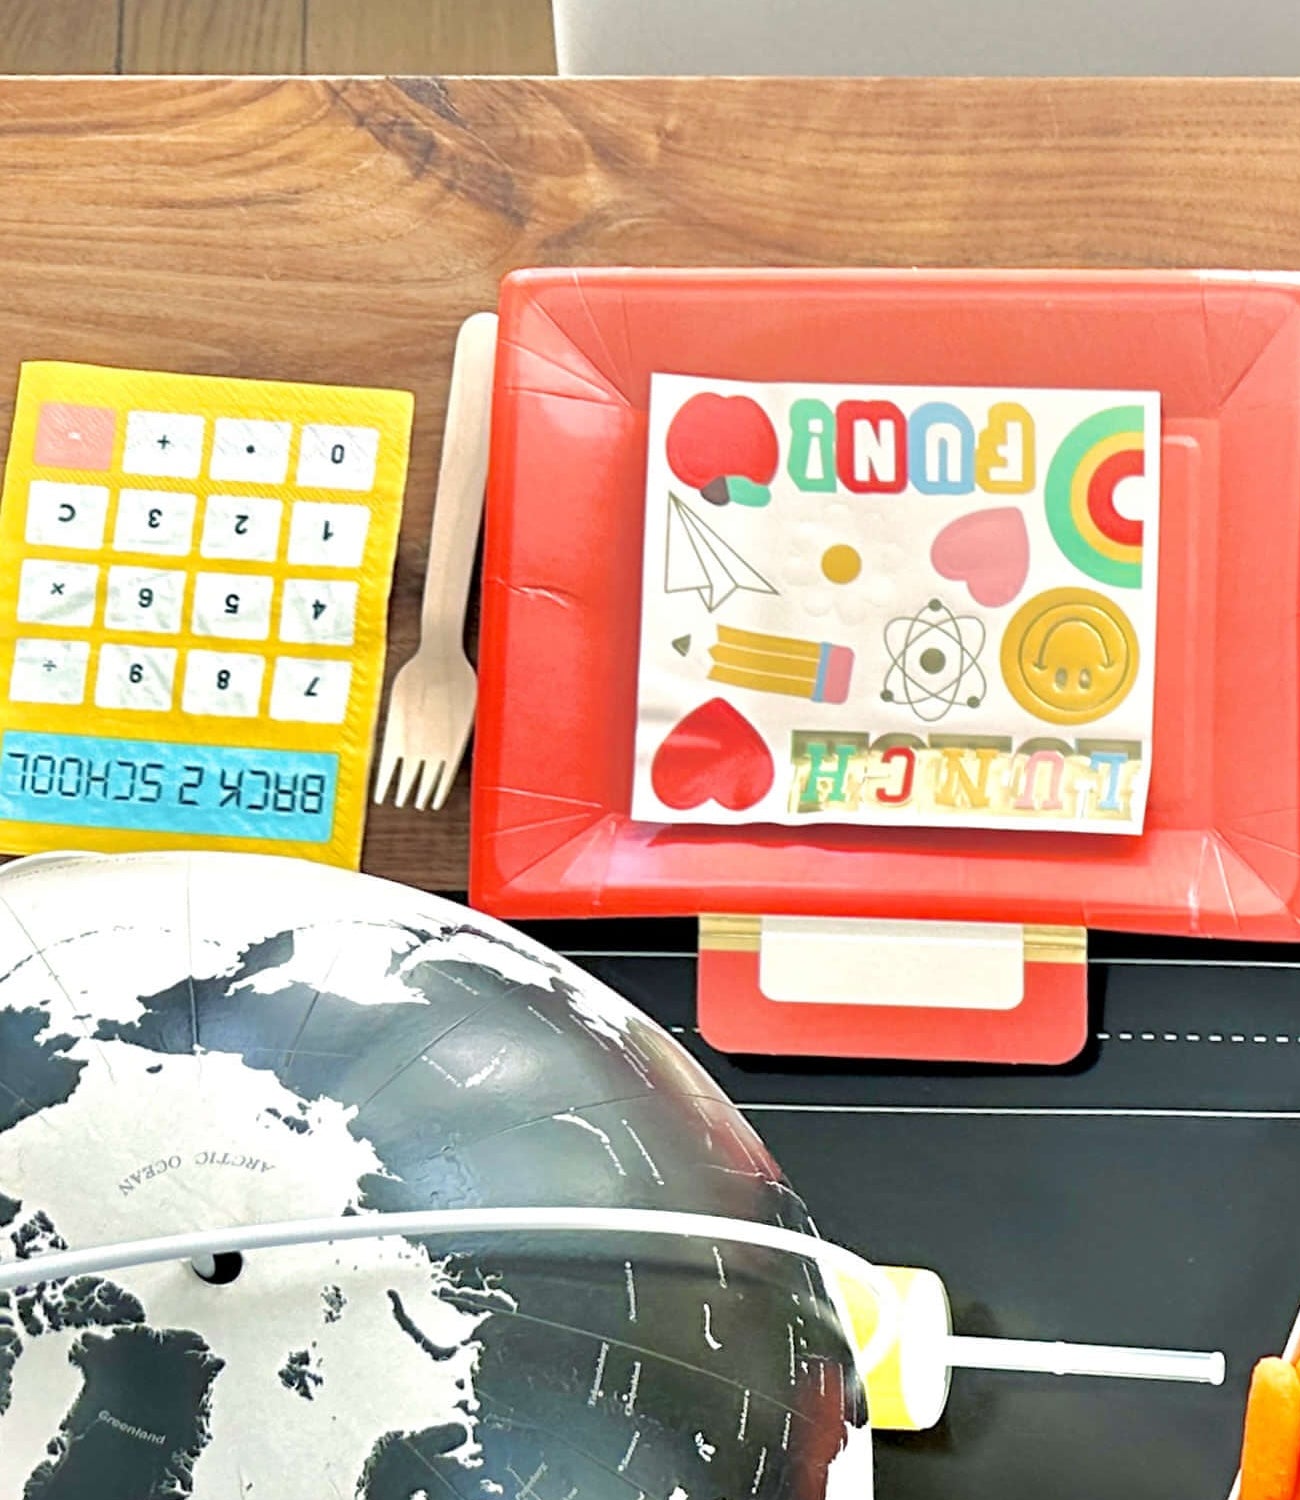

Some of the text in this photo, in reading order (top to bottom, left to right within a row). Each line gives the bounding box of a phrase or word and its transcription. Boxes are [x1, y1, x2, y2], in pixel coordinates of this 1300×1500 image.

[331, 444, 345, 465] 0
[797, 409, 1030, 489] FUN!
[58, 503, 333, 541] 1 2 3 C
[138, 588, 153, 608] 6
[225, 593, 240, 614] 5
[312, 600, 326, 620] 4
[129, 663, 143, 684] 9
[217, 669, 231, 690] 8
[304, 677, 319, 697] 7
[7, 752, 325, 814] BACK 2 SCHOOL
[795, 737, 1134, 812] LUNCH
[118, 1151, 276, 1197] ARCTIC OCEAN
[99, 1409, 167, 1445] Greenland
